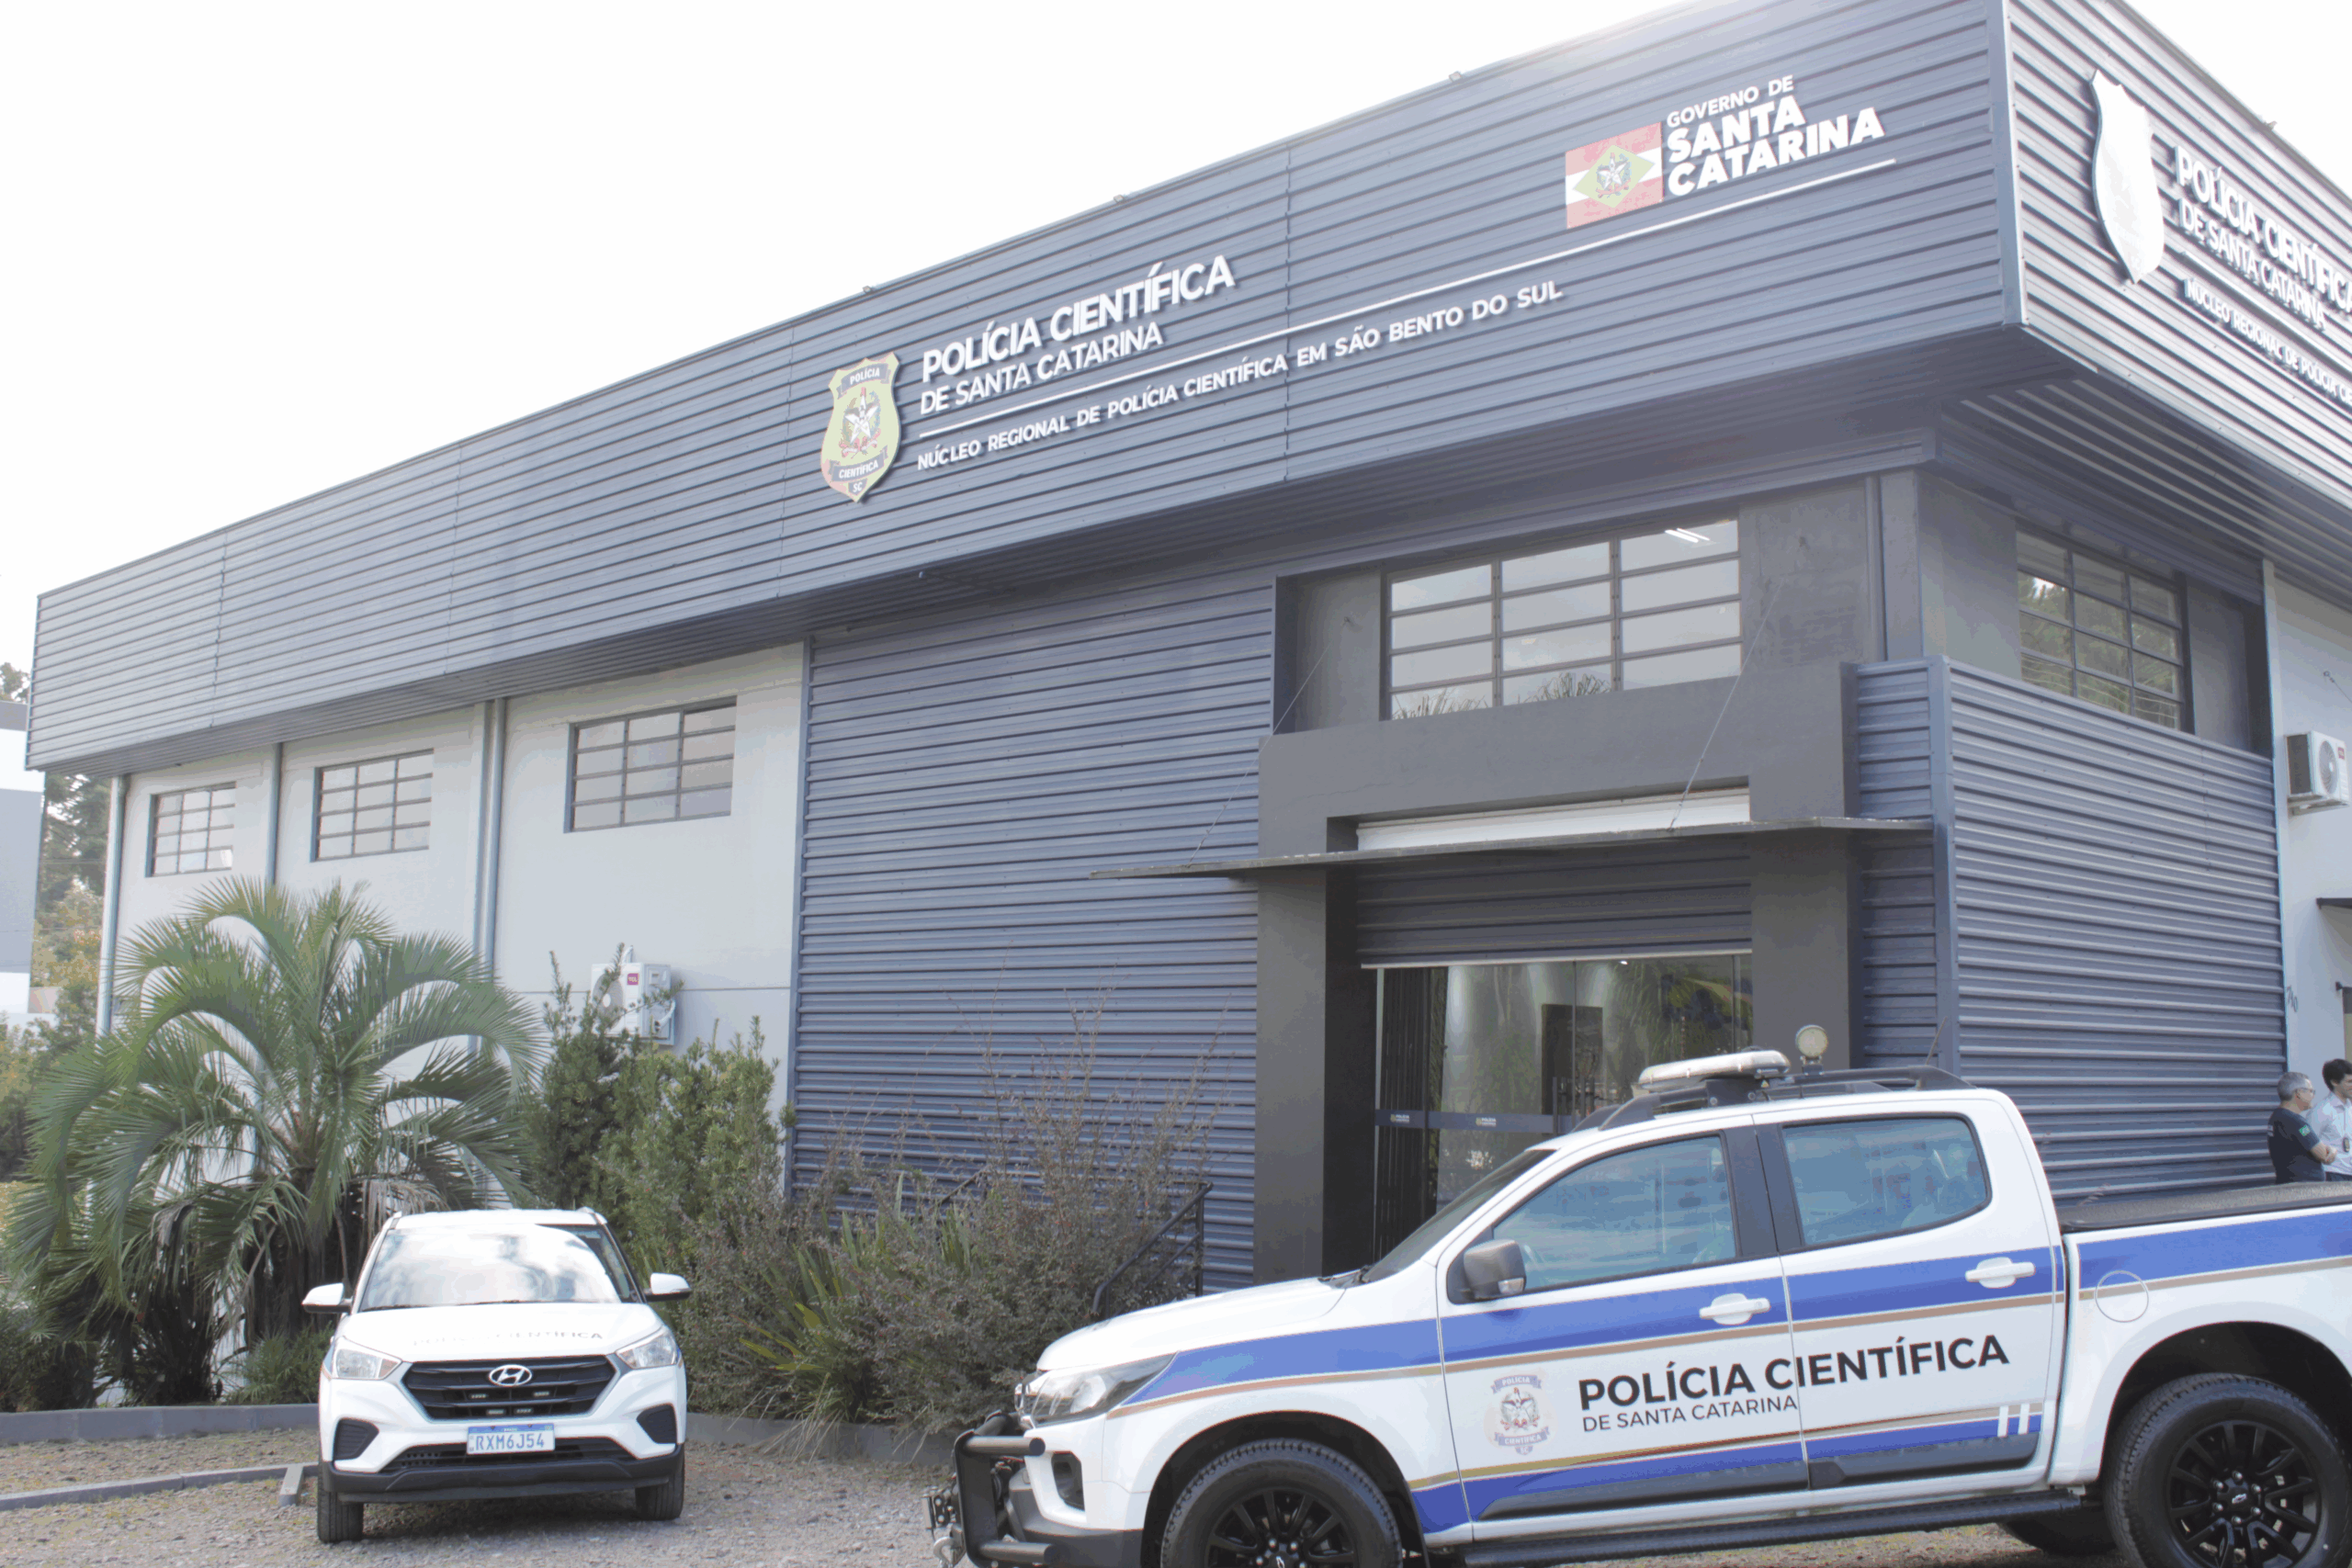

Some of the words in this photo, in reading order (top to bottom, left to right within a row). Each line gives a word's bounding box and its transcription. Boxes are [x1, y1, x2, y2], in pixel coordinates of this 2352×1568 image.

[1667, 86, 1758, 128] GOVERNO
[1769, 74, 1793, 96] DE
[1668, 95, 1806, 164] SANTA
[1668, 107, 1885, 197] CATARINA
[2176, 145, 2260, 243] POLÍCIA
[2179, 197, 2205, 243] DE
[2206, 220, 2260, 287] SANTA
[2261, 259, 2326, 333] CATARINA
[923, 316, 1042, 383] POLÍCIA
[1050, 254, 1236, 341] CIENTÍFICA
[2231, 310, 2283, 360] REGIONAL
[2283, 345, 2299, 370] DE
[850, 367, 879, 385] POLÍCIA
[918, 444, 981, 470] NÚCLEO
[988, 415, 1070, 451] REGIONAL
[1077, 405, 1101, 427] DE
[1108, 385, 1179, 418] POLÍCIA
[1183, 355, 1288, 397] CIENTÍFICA
[1296, 343, 1327, 367] EM
[1335, 325, 1381, 356] SÃO
[1388, 307, 1464, 342] BENTO
[1472, 295, 1508, 320] DO
[1517, 281, 1562, 309] SUL
[921, 385, 951, 414] DE
[956, 362, 1032, 405] SANTA
[1037, 321, 1164, 380] CATARINA
[839, 459, 878, 479] CIENTÍFICA
[853, 482, 863, 492] SC
[1578, 1361, 1756, 1410] POLÍCIA
[1765, 1335, 2010, 1390] CIENTÍFICA
[476, 1434, 544, 1450] RXM6J54
[1583, 1415, 1611, 1432] DE
[1617, 1407, 1686, 1428] SANTA
[1691, 1394, 1798, 1420] CATARINA
